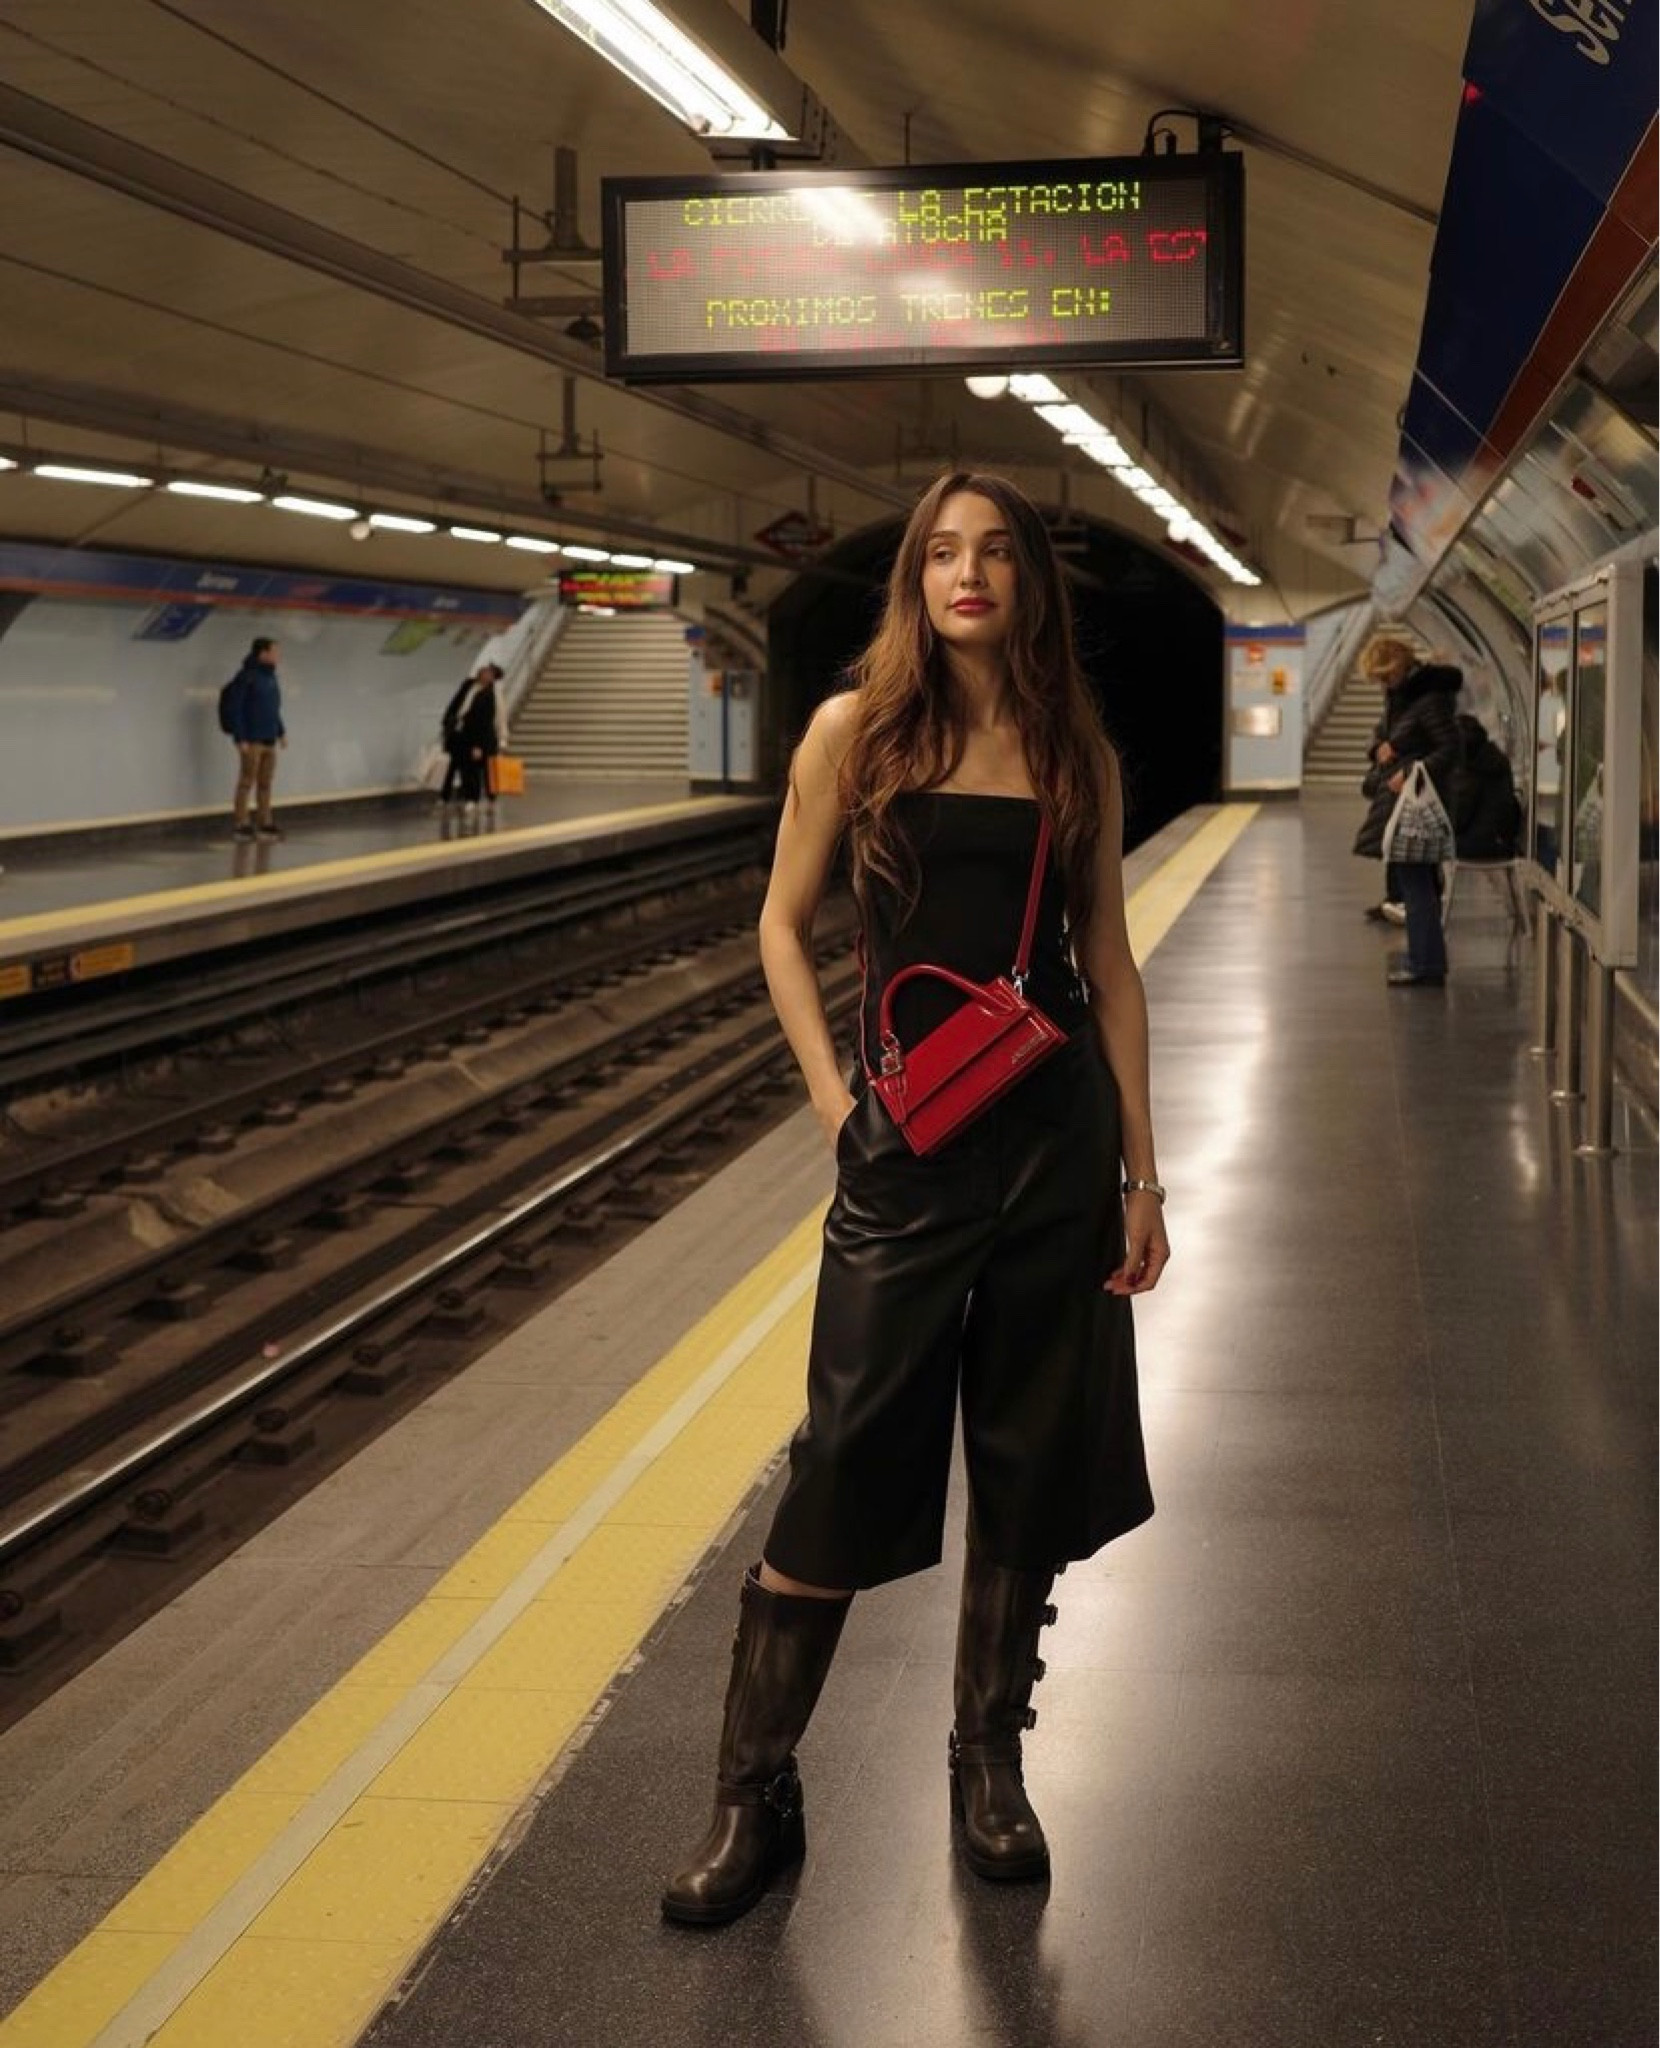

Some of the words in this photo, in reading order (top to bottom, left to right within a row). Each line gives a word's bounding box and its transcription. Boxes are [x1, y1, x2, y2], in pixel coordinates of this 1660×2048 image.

[963, 181, 1141, 216] ESTACION
[1080, 235, 1131, 267] LA
[706, 296, 877, 330] PROXIMOS
[900, 290, 1028, 322] TRENES
